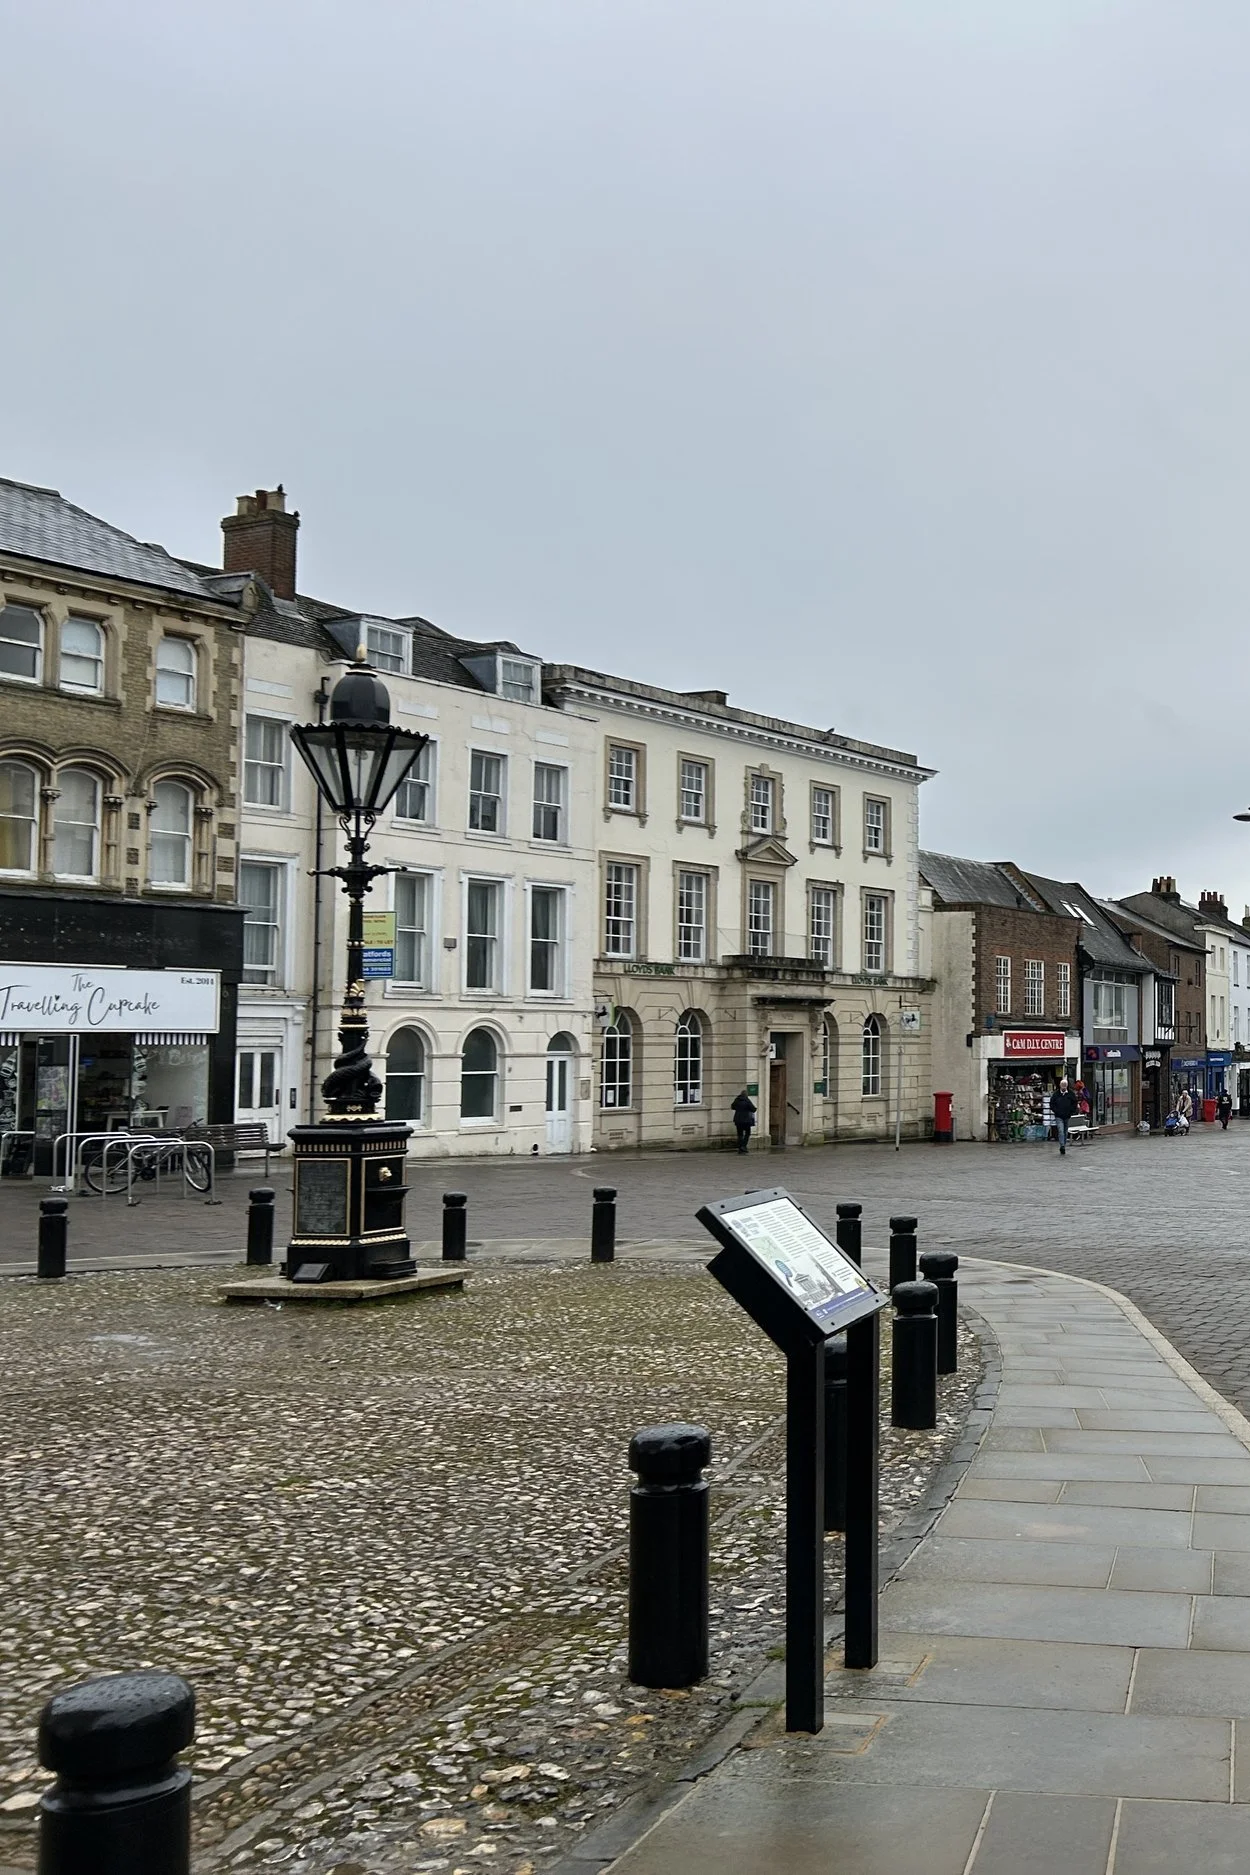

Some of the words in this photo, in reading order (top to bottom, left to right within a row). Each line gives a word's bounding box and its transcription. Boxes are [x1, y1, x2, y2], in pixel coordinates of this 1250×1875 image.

[363, 950, 391, 958] atfords
[623, 963, 653, 974] LLOYDS
[655, 964, 675, 976] BANK
[71, 972, 94, 992] The
[0, 984, 82, 1025] Travelling
[87, 987, 160, 1026] Cupcake
[1041, 1039, 1063, 1050] CENTRE
